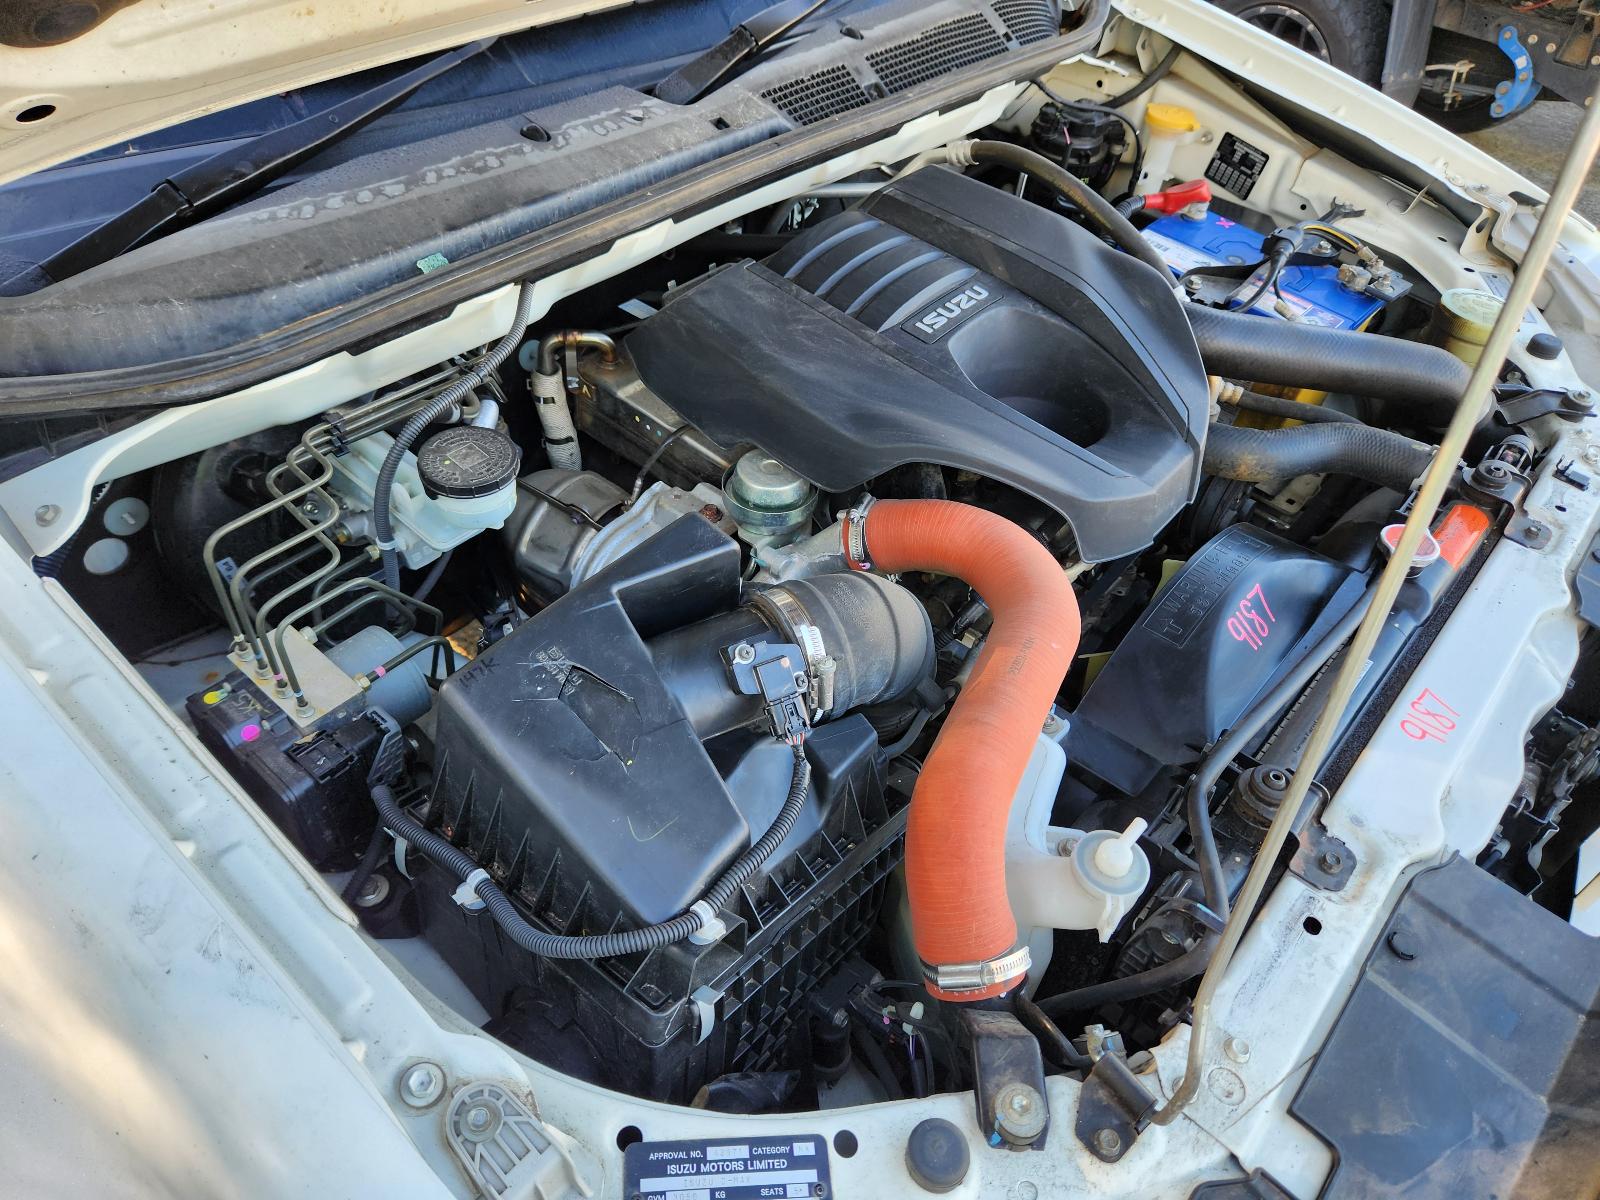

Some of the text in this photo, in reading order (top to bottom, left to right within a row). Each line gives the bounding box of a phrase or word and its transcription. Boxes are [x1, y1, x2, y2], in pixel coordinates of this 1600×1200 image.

[914, 285, 990, 334] ISUZU
[1226, 583, 1277, 652] 9187
[1400, 687, 1461, 744] 9187
[649, 1151, 688, 1161] APPROVAL
[690, 1150, 704, 1159] NO.
[752, 1146, 791, 1156] CATEGORY
[667, 1159, 788, 1175] ISUZU MOTORS LIMITED
[715, 1190, 726, 1199] KG
[760, 1187, 784, 1196] SEATS
